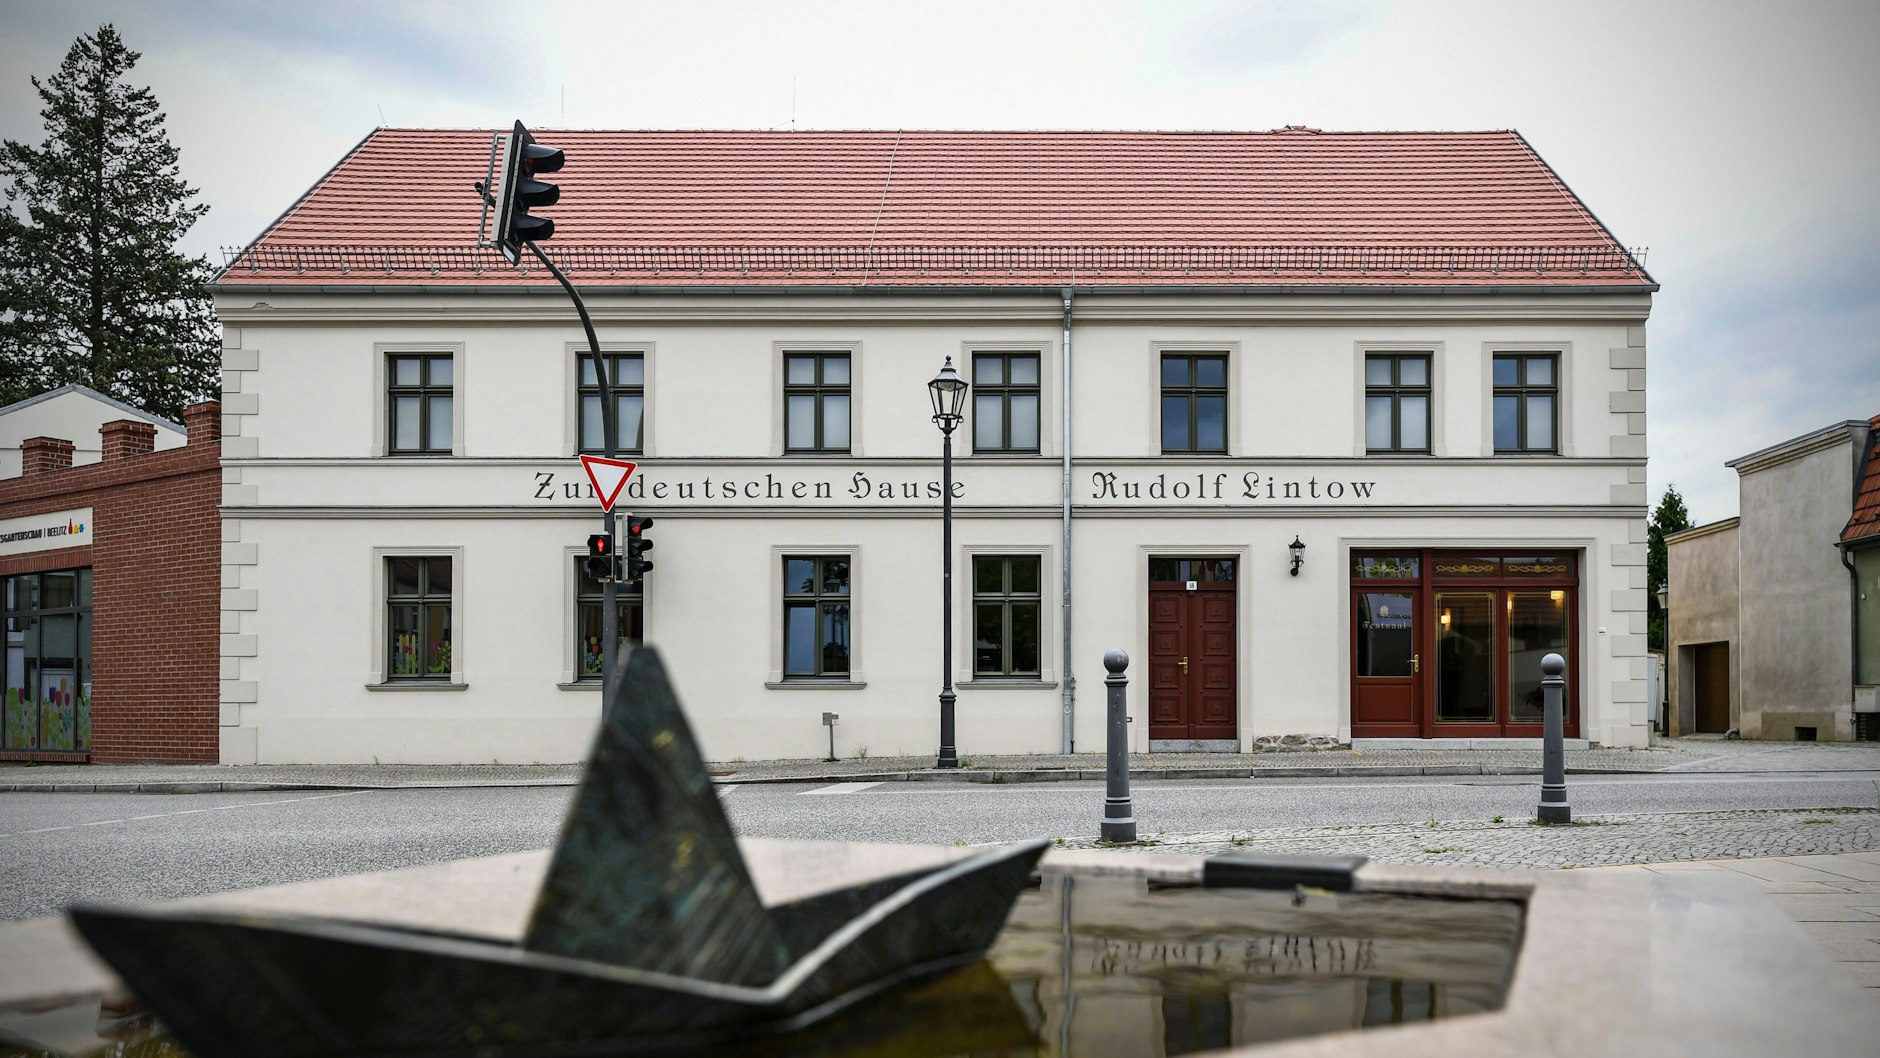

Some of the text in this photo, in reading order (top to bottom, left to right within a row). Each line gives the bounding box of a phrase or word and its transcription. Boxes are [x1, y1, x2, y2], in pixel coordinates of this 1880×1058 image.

[628, 473, 833, 500] deutschen
[848, 471, 965, 499] Hause
[1092, 471, 1376, 500] Rudolf Lintow
[47, 526, 67, 537] BEELITZ
